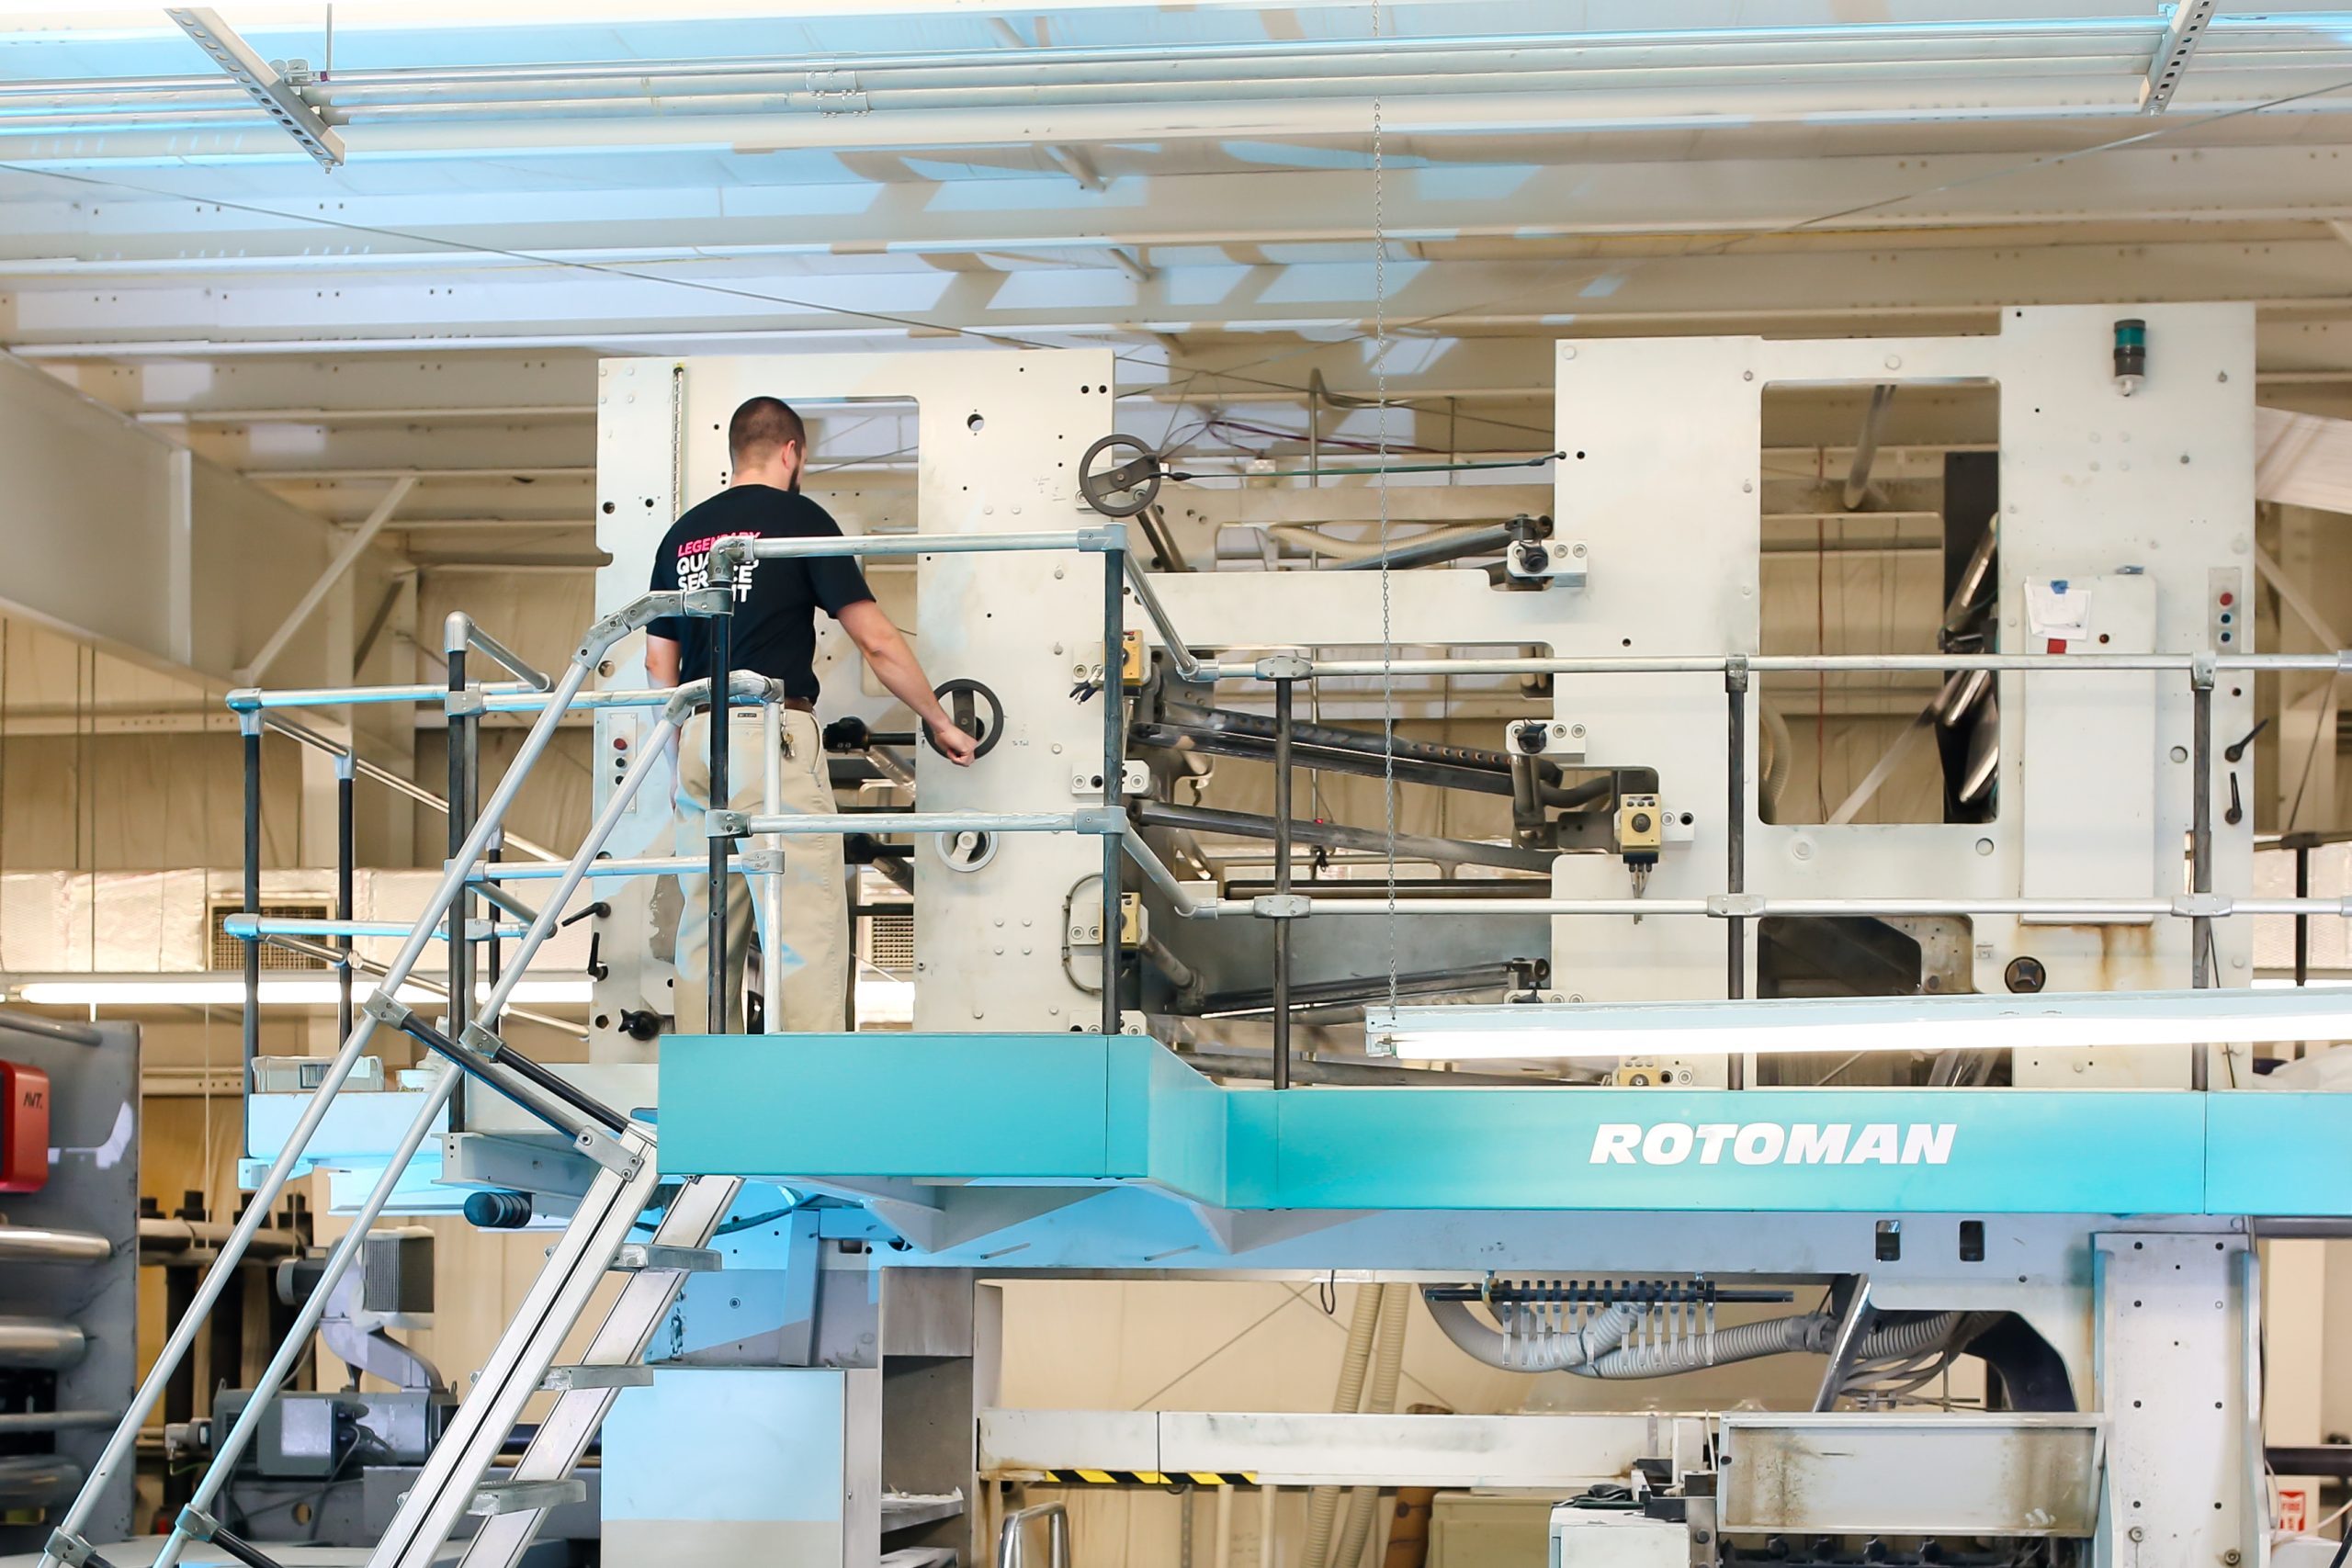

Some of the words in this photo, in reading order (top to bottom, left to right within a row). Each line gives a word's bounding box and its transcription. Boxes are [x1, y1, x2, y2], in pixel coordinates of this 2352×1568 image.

[677, 531, 761, 557] LEGEN
[677, 565, 752, 592] SERE
[1589, 1122, 1957, 1165] ROTOMAN
